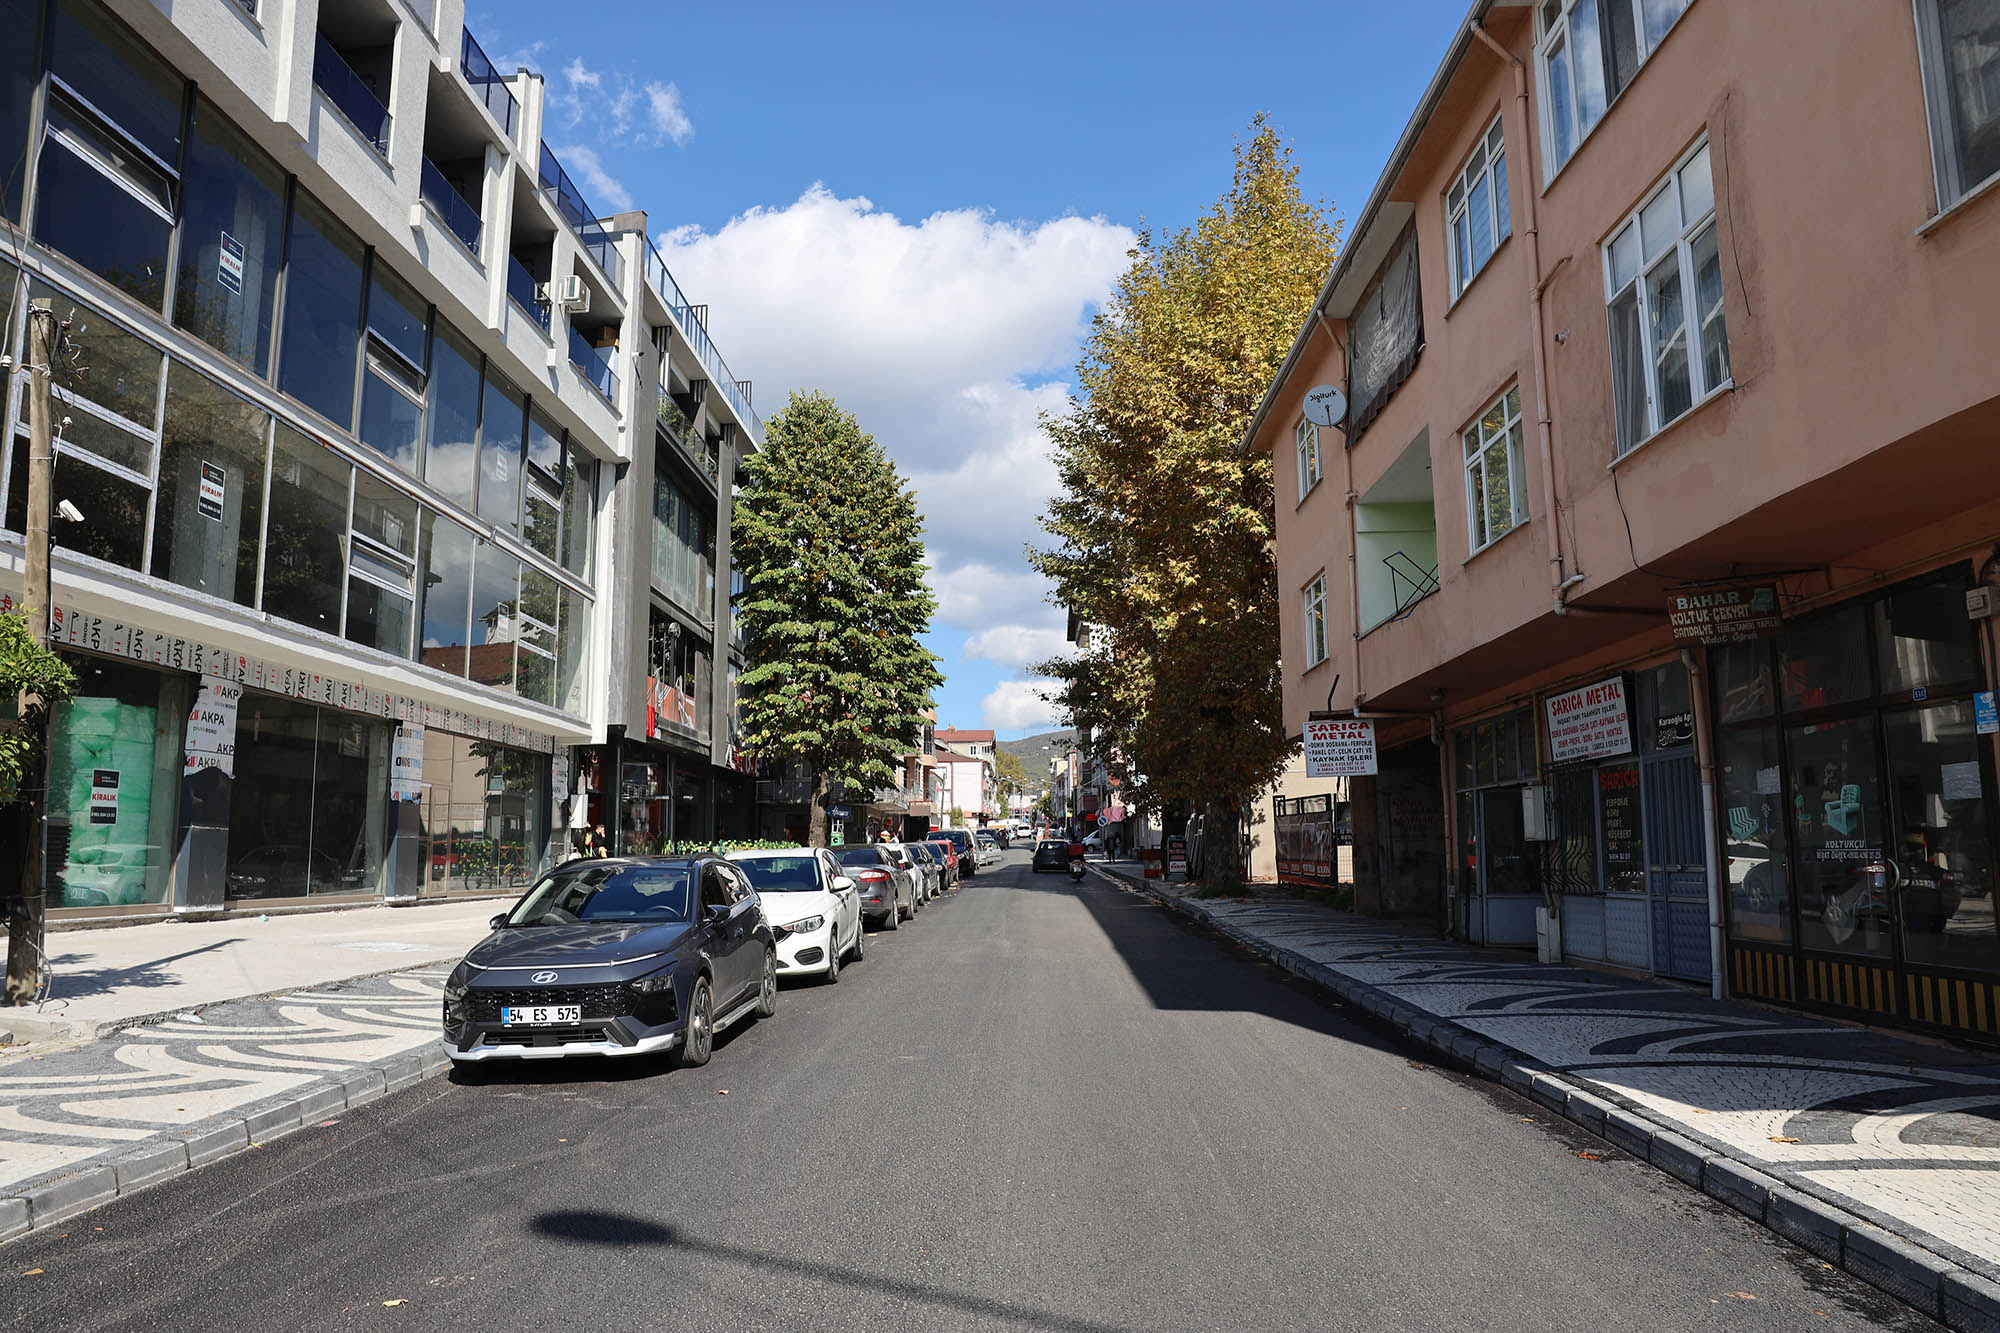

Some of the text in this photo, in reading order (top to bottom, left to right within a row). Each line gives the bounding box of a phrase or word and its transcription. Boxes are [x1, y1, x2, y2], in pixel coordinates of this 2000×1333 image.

[1676, 592, 1740, 610] BAHAR
[1673, 623, 1713, 638] SANDALYE
[1551, 682, 1621, 717] SARICA METAL
[201, 710, 225, 726] AKPA
[1308, 722, 1369, 732] SARICA
[1312, 732, 1366, 740] METAL
[1347, 754, 1372, 762] İŞLERİ
[1824, 840, 1865, 850] KOLTUKÇU
[509, 1007, 579, 1022] 54 ES 575
